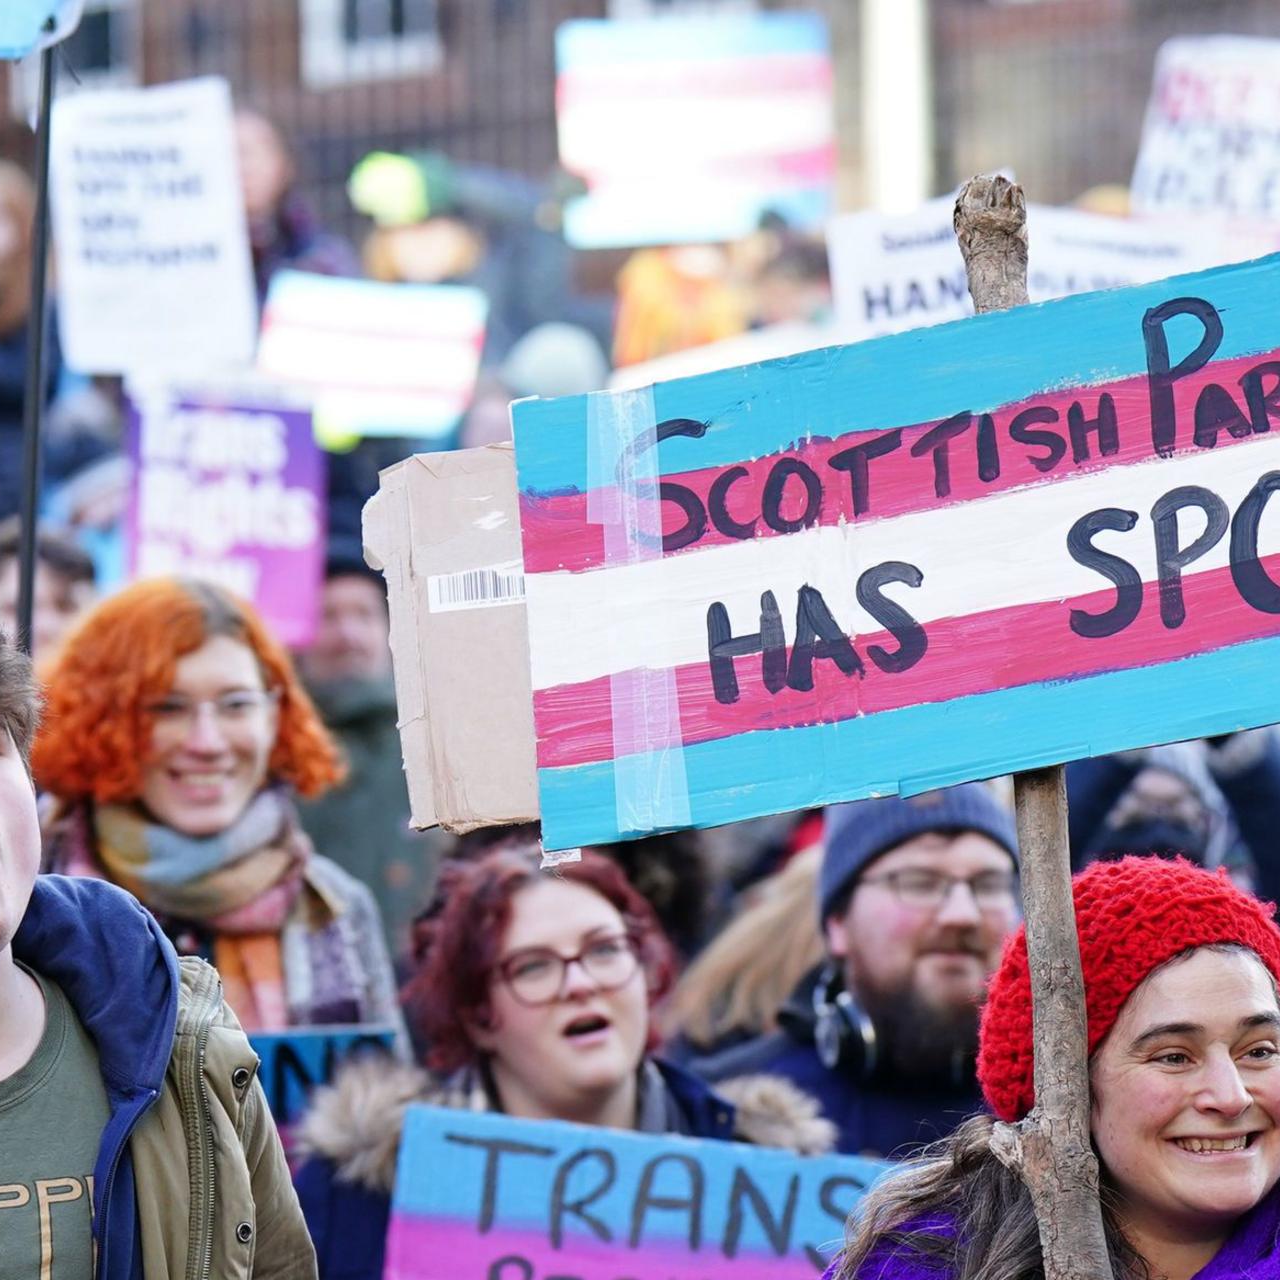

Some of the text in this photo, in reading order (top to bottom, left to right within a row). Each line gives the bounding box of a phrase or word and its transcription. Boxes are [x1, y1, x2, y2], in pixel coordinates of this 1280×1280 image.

[616, 392, 1119, 550] SCOTTISH
[706, 560, 928, 703] HAS
[444, 1132, 867, 1268] TRANS
